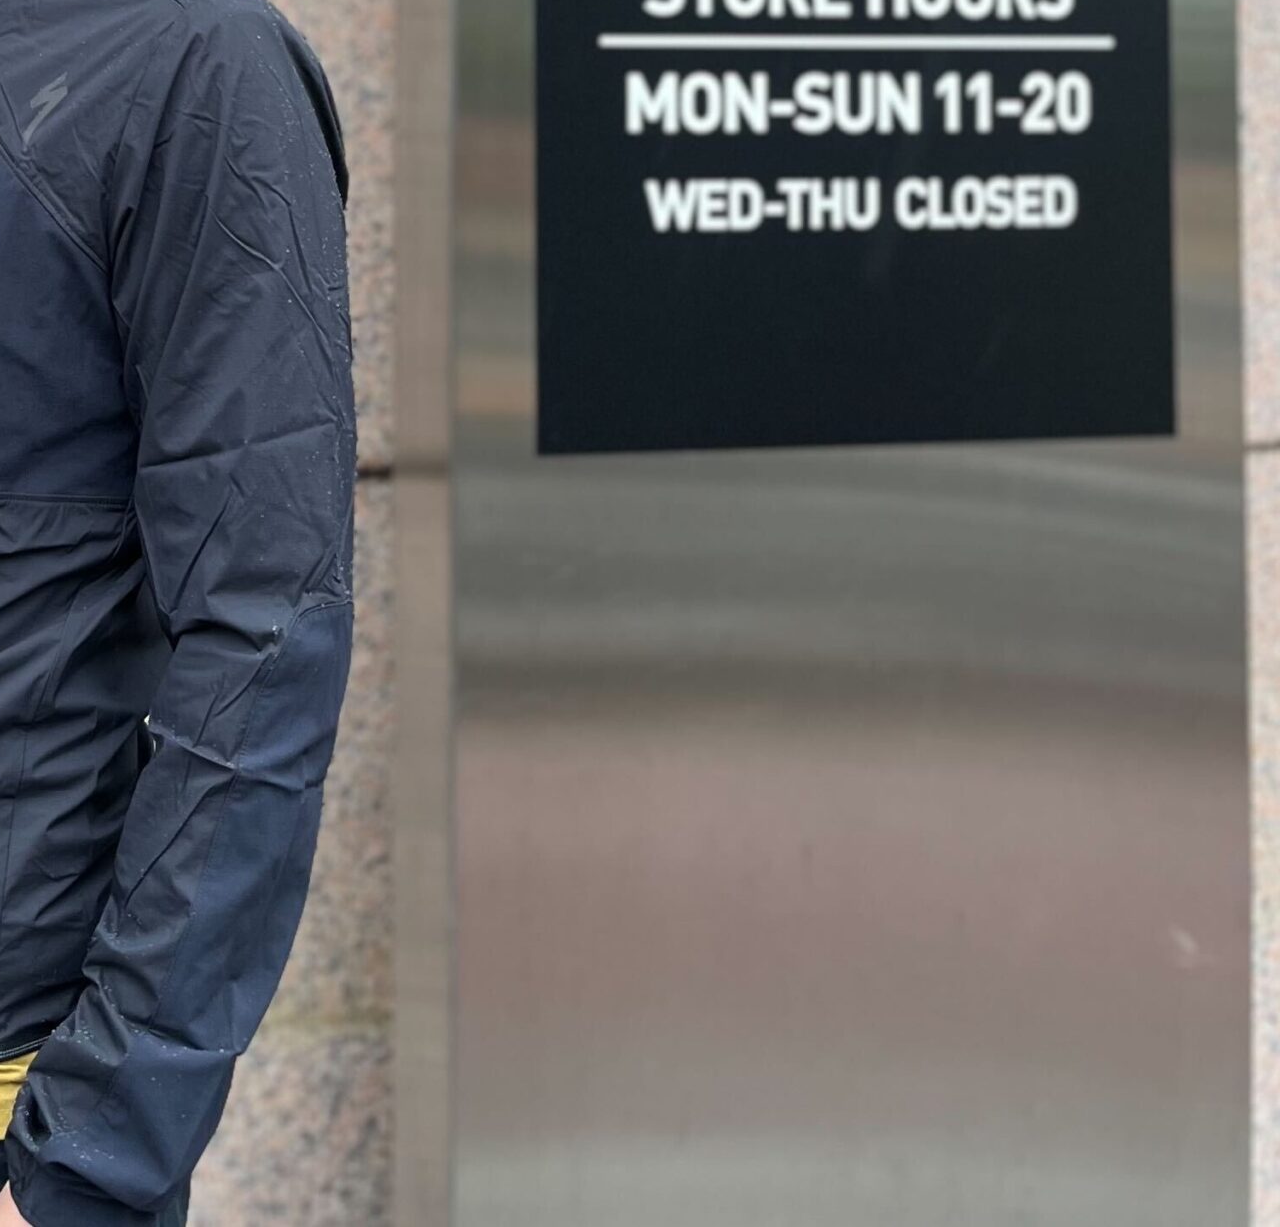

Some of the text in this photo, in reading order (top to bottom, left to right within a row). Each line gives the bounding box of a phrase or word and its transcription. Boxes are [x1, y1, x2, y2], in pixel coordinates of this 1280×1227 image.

[624, 70, 1092, 134] MON-SUN 11-20
[643, 175, 1078, 232] WED-THU CLOSED
